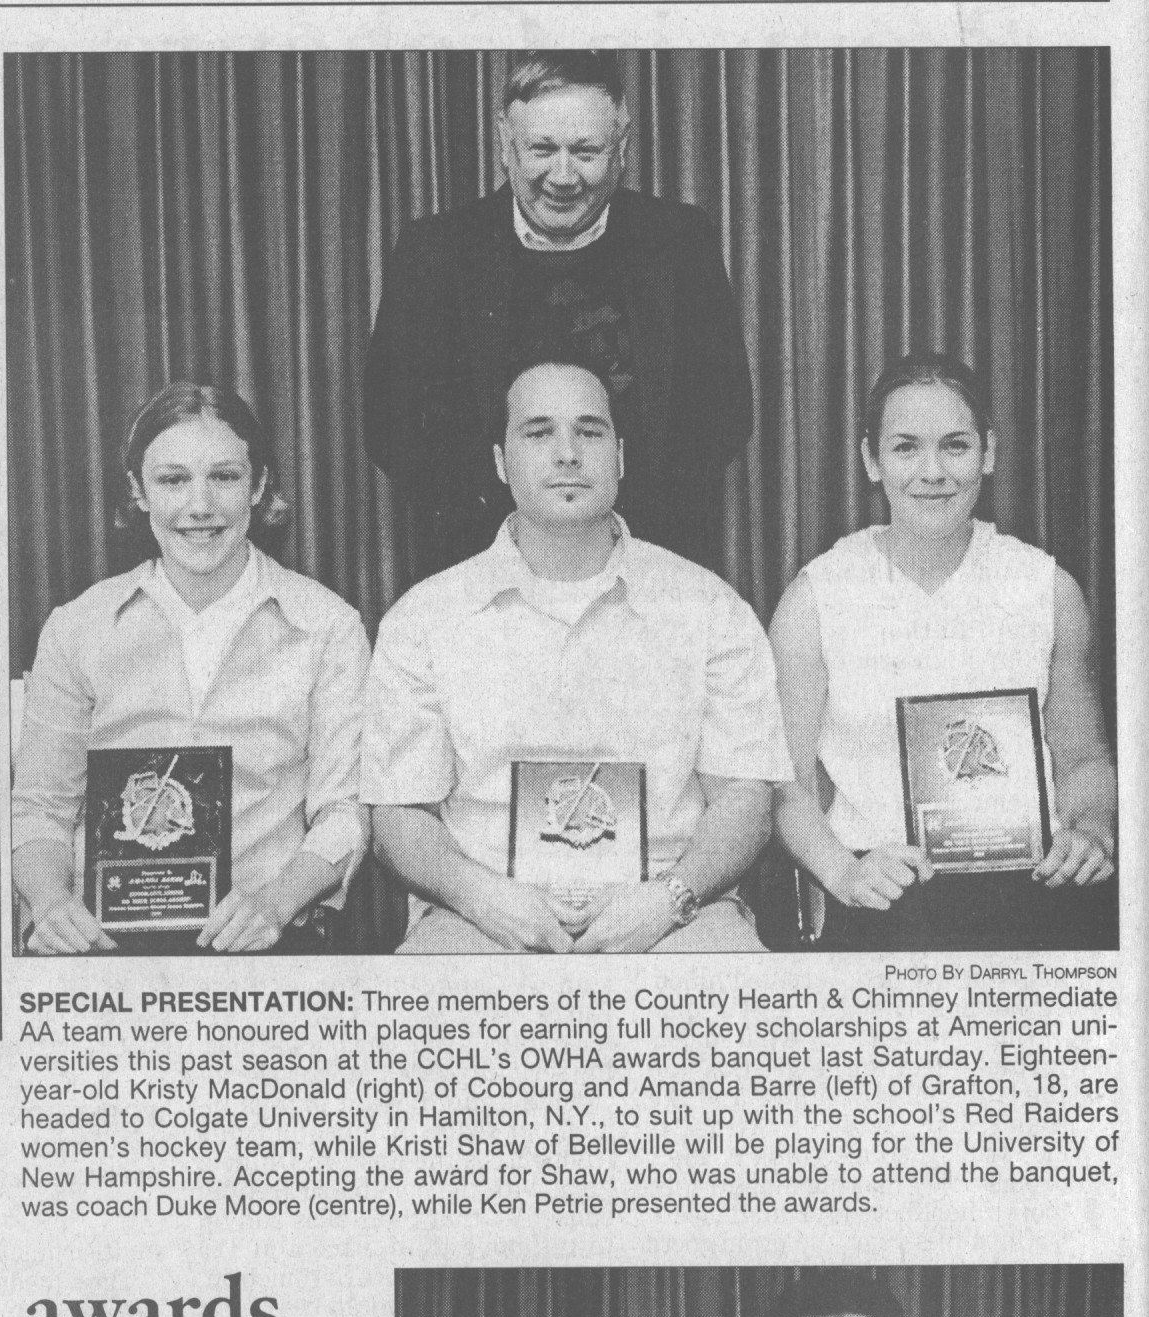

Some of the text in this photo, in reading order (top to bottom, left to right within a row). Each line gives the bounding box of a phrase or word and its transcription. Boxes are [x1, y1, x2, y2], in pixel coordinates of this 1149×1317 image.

[885, 964, 1117, 980] PHOTO BY DARRYL THOMPSON
[20, 986, 1117, 1015] SPECIAL PRESENTATION: Three members of the Country Hearth & Chimney Intermediate
[20, 1073, 1118, 1105] year-old Kristy MacDonald (right) of Cobourg and Amanda Barre (left) of Grafton, 18, are
[21, 1192, 877, 1220] was coach Duke Moore (centre), while Ken Petrie presented the awards.
